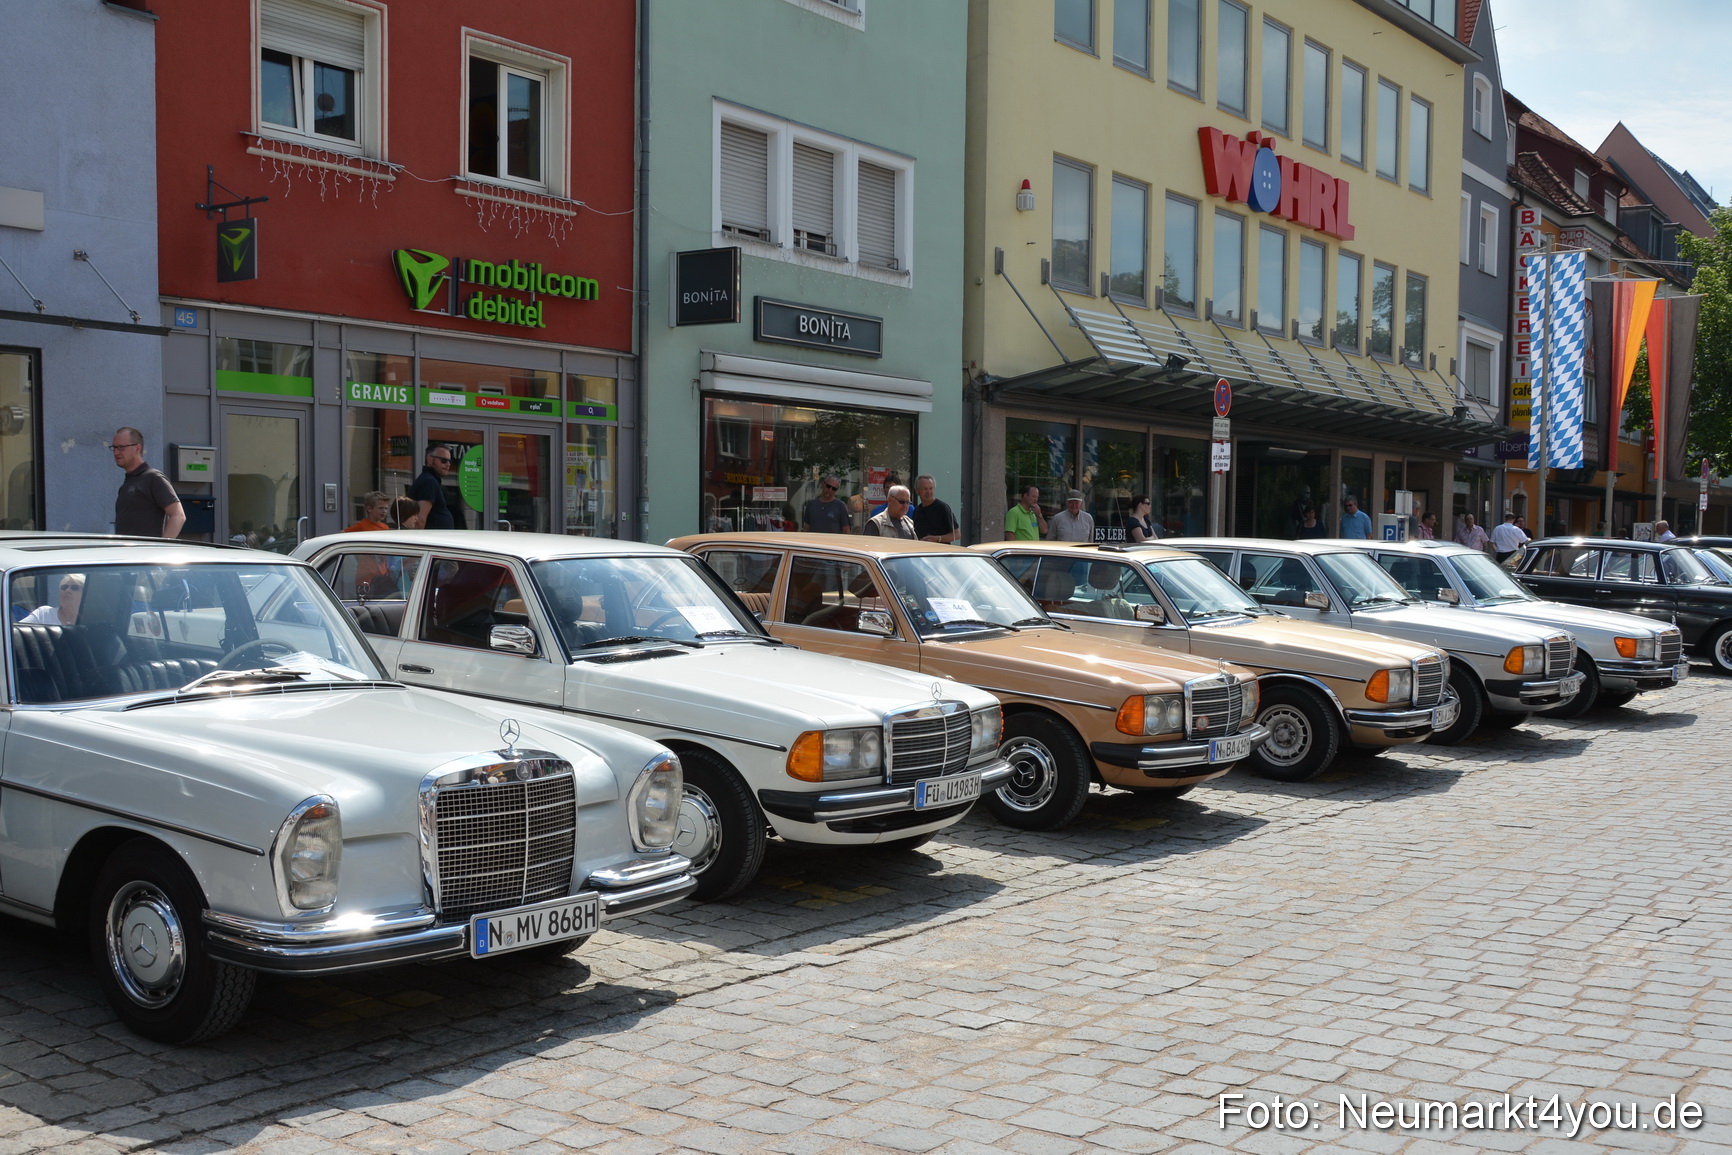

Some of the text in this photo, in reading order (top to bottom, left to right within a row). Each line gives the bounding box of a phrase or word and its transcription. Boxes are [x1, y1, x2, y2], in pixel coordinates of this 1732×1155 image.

[1198, 126, 1356, 241] WÖHRL
[464, 258, 599, 301] mobilcom
[178, 311, 194, 325] 45
[464, 291, 547, 329] debitel
[351, 383, 407, 403] GRAVIS
[1512, 384, 1532, 397] café
[1095, 528, 1105, 541] ES
[1386, 528, 1394, 541] P
[1226, 741, 1236, 757] BA
[925, 784, 940, 804] FÜ
[946, 776, 979, 800] U1983H
[479, 902, 596, 948] D N MV 868H
